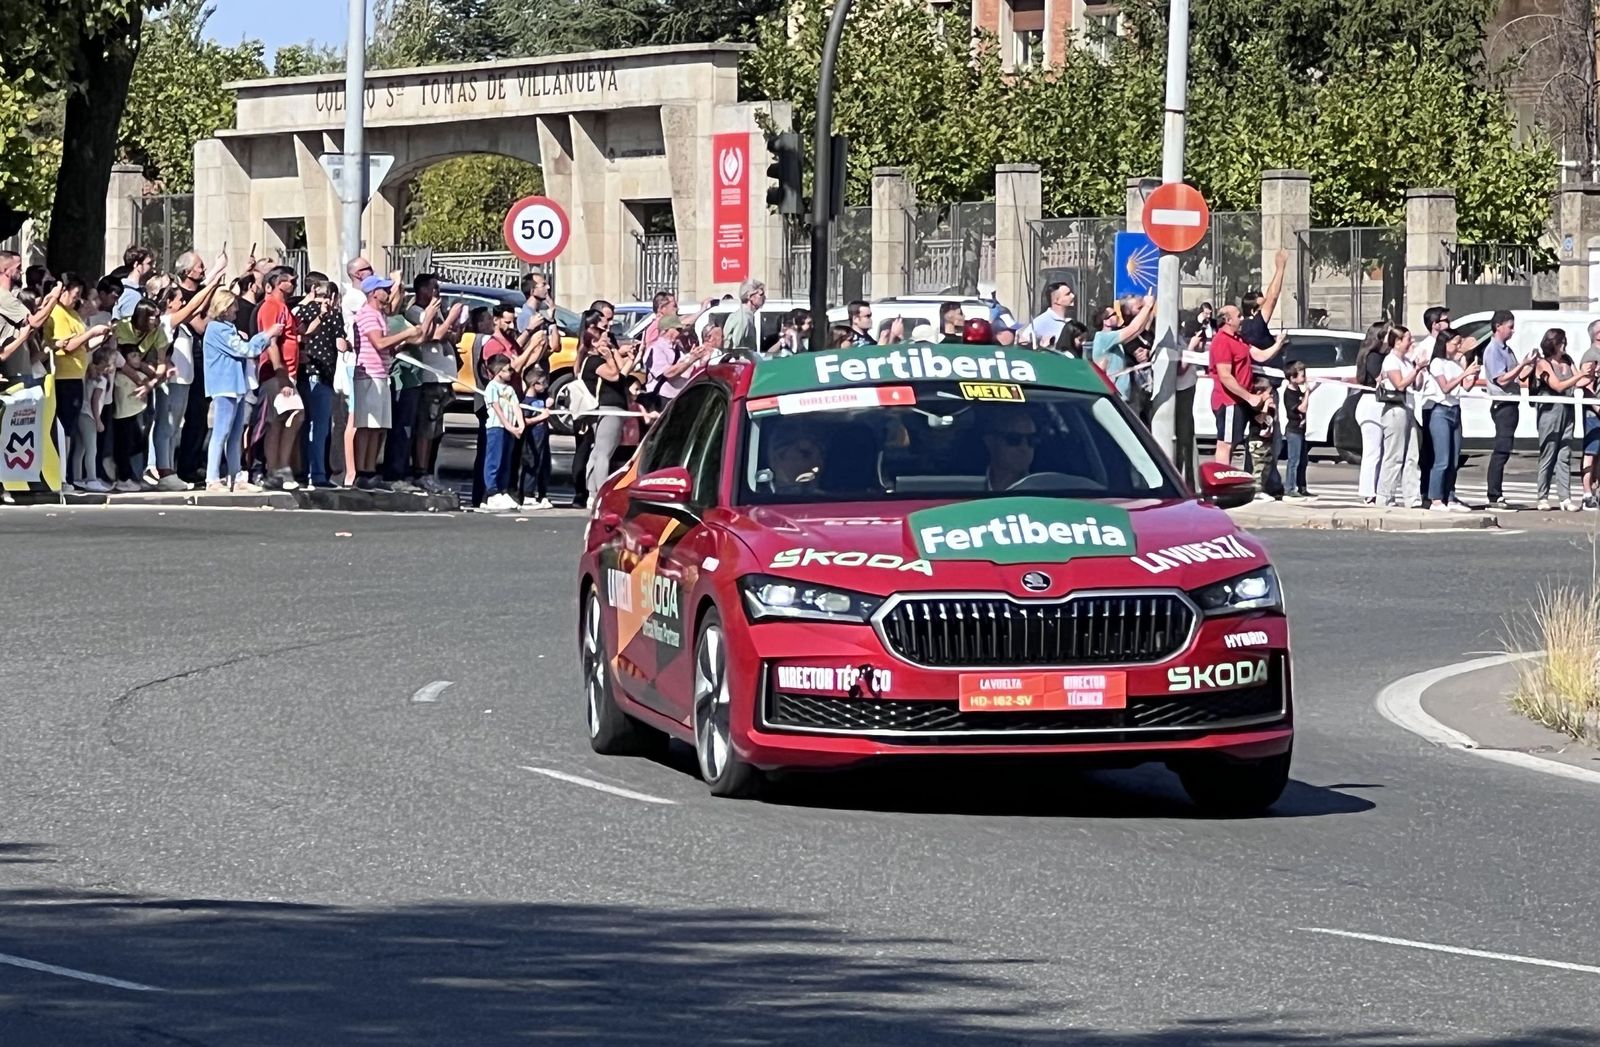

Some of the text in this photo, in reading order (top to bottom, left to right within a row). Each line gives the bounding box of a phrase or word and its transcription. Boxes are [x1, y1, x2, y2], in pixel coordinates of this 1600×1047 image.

[316, 84, 375, 111] COLO
[487, 73, 506, 100] DE
[517, 65, 618, 97] VILLANUEVA
[521, 219, 554, 240] 50
[815, 347, 1036, 383] Fertiberia
[920, 513, 1127, 554] Fertiberia
[769, 547, 933, 577] SKODA
[1224, 631, 1269, 648] HYBRID
[778, 666, 834, 690] DIRECTOR
[1167, 659, 1268, 692] SKODA
